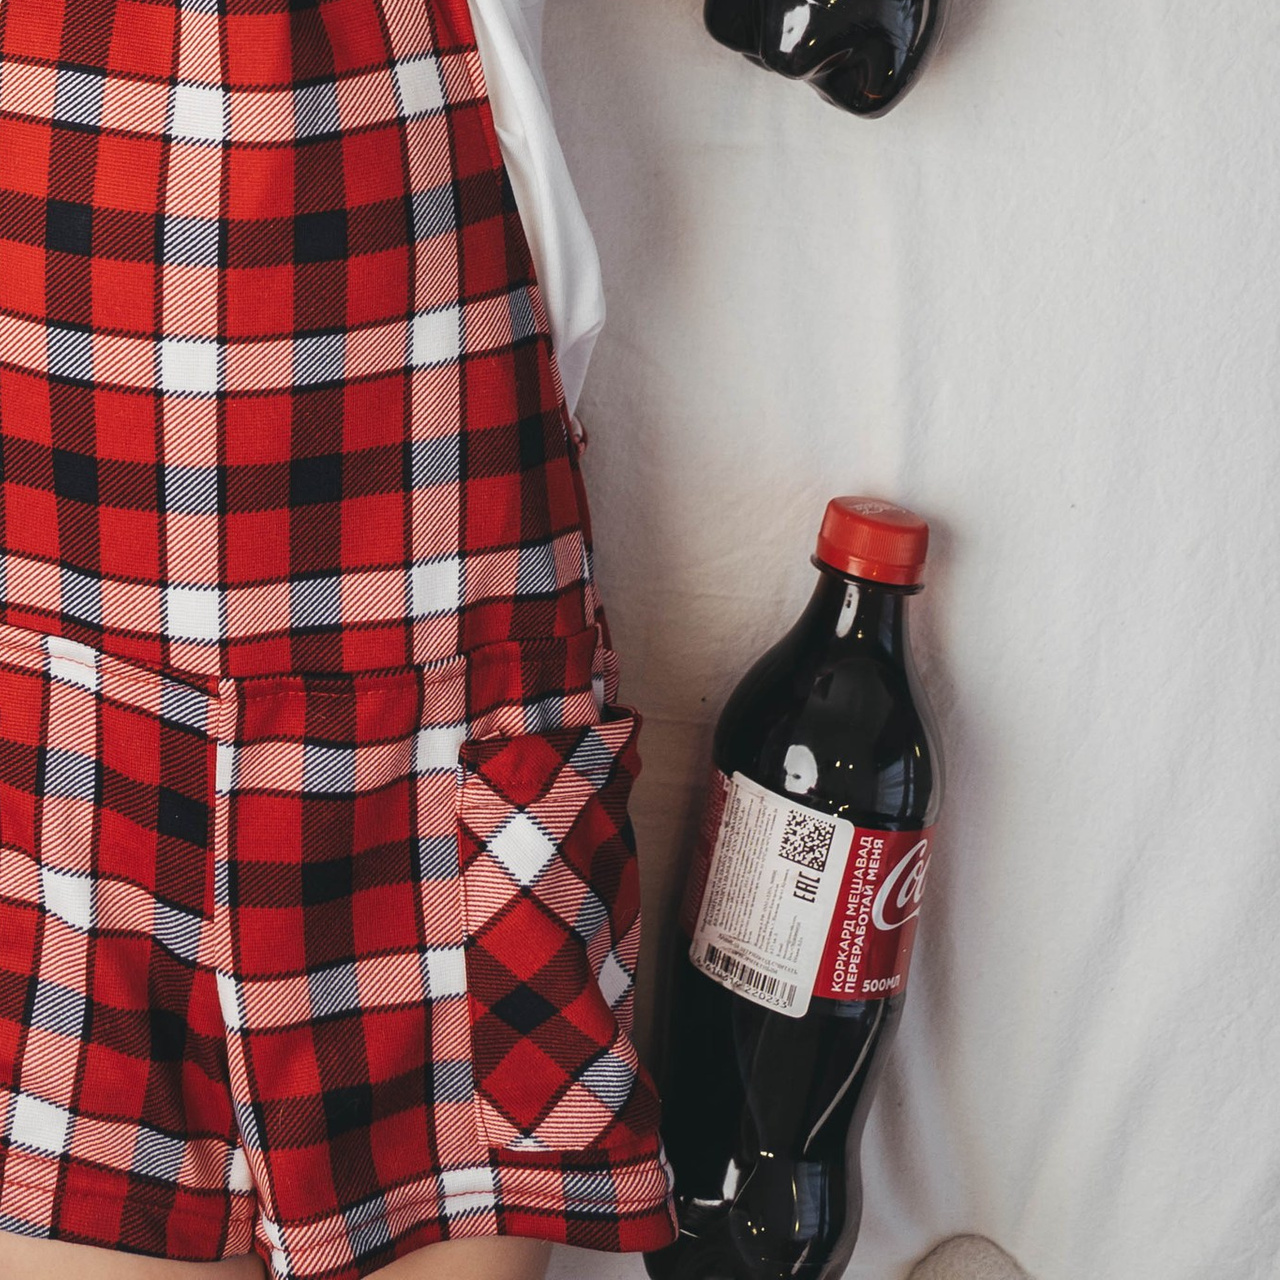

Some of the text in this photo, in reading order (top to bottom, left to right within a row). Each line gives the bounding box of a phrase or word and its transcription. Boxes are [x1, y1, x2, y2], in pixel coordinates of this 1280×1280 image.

[831, 836, 874, 992] КОРКАРД МЕШАВАД
[844, 838, 884, 993] ПЕРЕРАБОТАЙ МЕНЯ
[861, 973, 900, 994] 500МЛ
